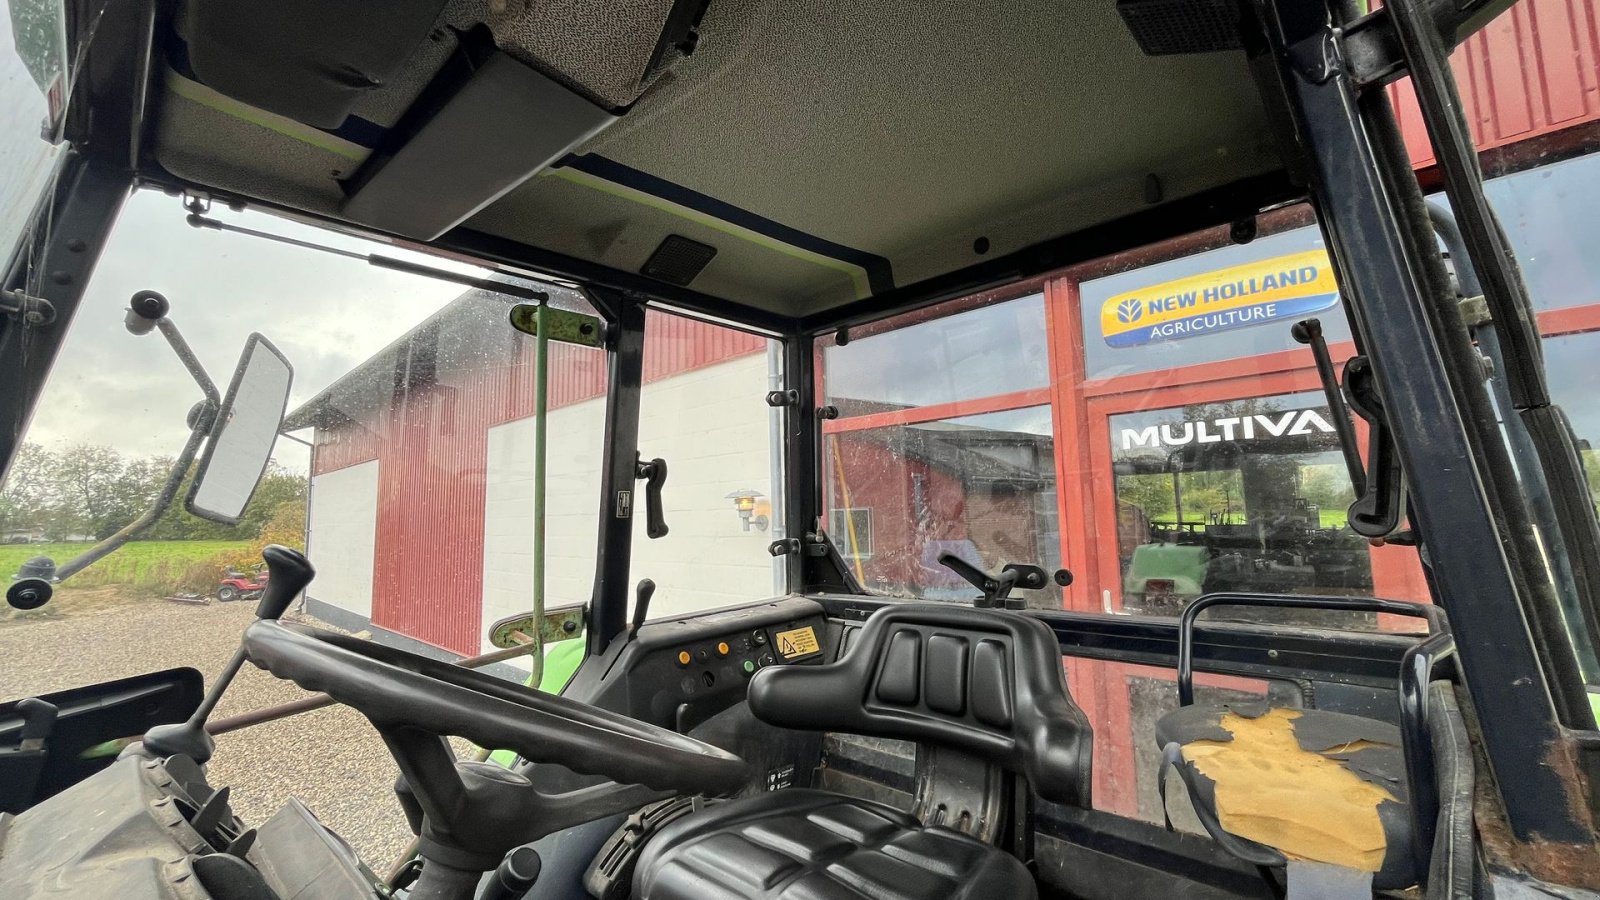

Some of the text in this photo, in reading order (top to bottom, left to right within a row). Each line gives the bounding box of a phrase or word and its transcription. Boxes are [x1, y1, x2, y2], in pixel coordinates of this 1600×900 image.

[1148, 266, 1318, 315] NEW HOLLAND
[1151, 303, 1277, 339] AGRICULTURE
[1121, 409, 1337, 450] MULTIVA
